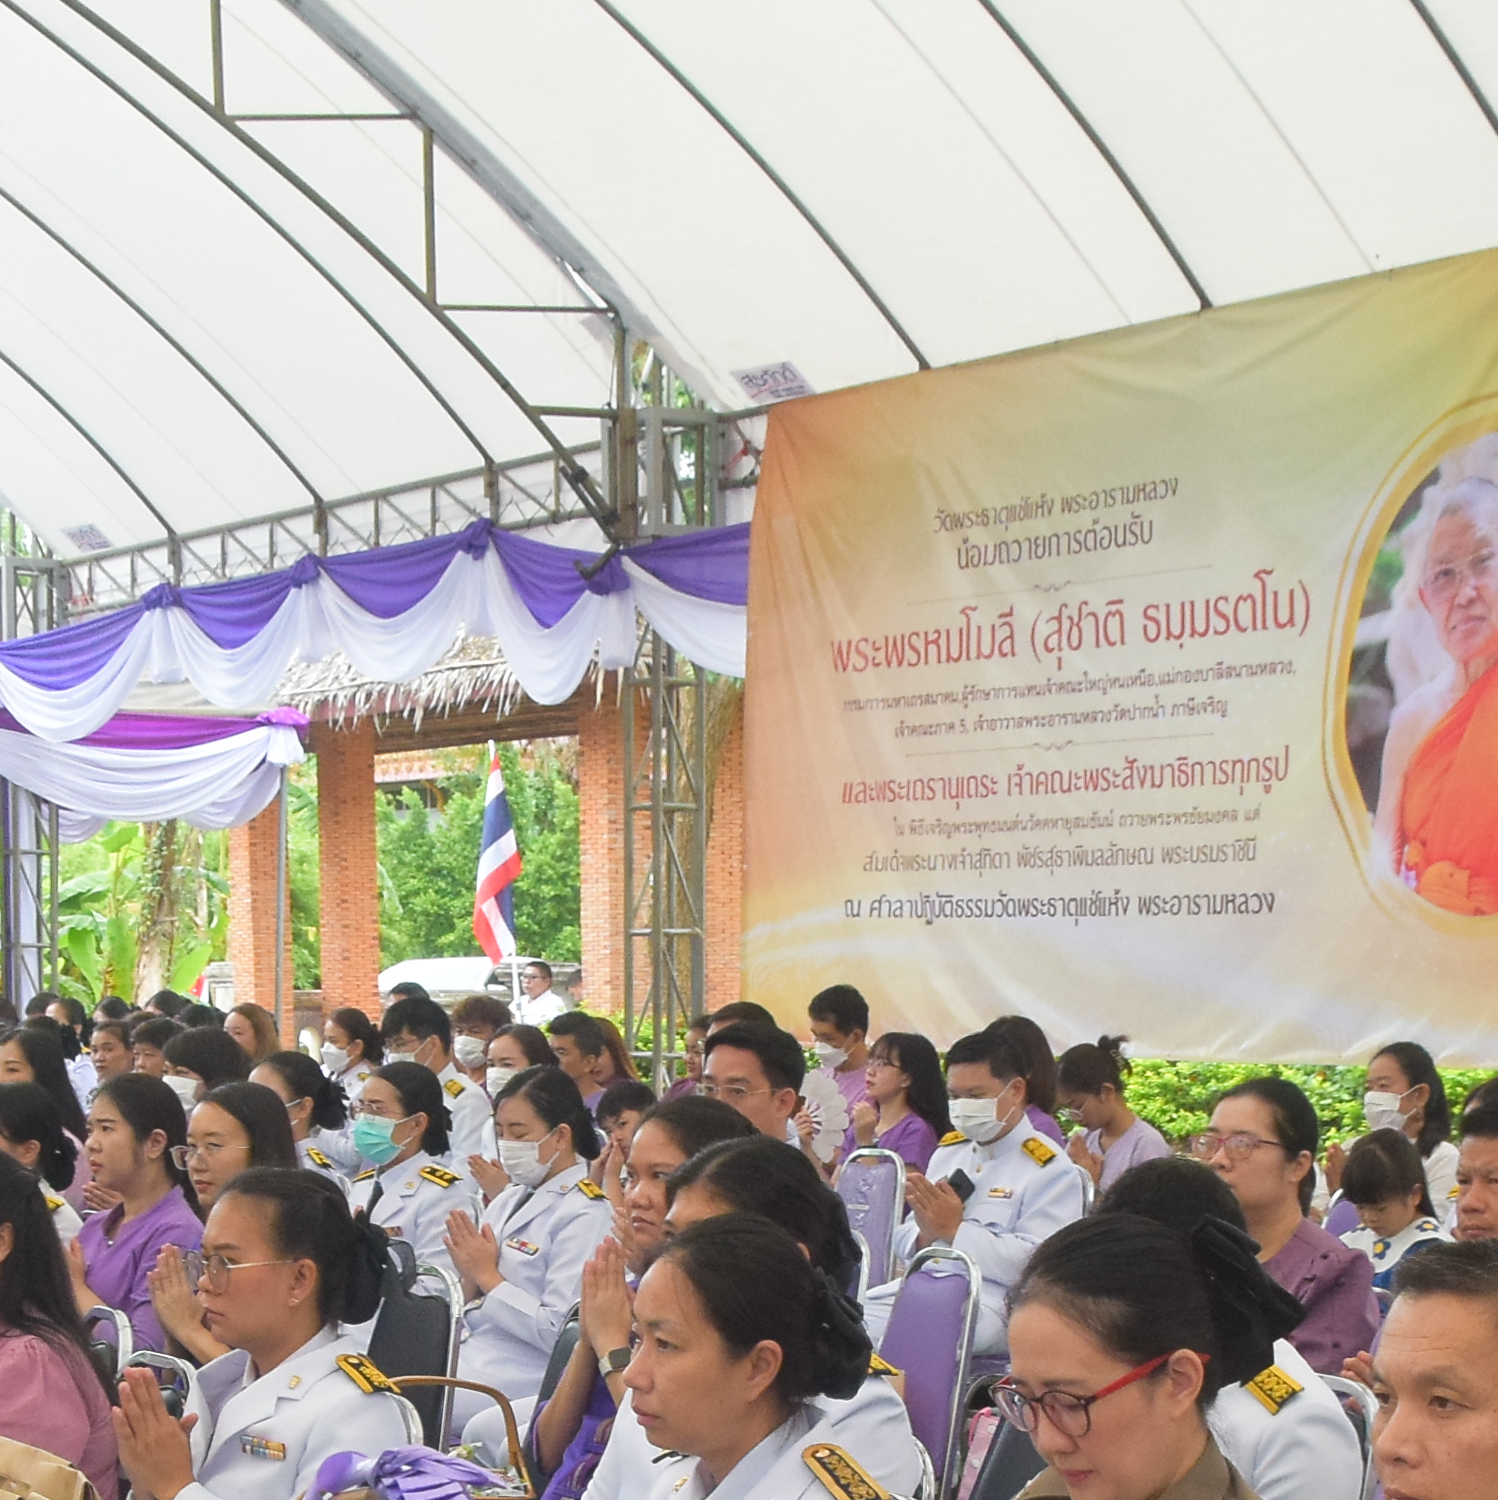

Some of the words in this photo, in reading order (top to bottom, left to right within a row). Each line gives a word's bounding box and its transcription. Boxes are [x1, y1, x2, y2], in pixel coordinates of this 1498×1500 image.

[1061, 476, 1180, 515] พระอารามหลวง
[957, 511, 1155, 571] น้อมถวายการต้อนรับ
[831, 604, 1017, 674] พระพรหมโมลี
[1030, 598, 1127, 671] (สุชาติ
[1170, 697, 1230, 722] ภาษีเจริญ
[841, 772, 1000, 811] และพระเถรานุเถระ
[1007, 744, 1291, 797] เจ้าคณะพระสังฆาธิการทุกรูป
[1161, 837, 1258, 865] พระบรมราชินี
[844, 897, 862, 919] ณ
[1137, 888, 1276, 920] พระอารามหลวง
